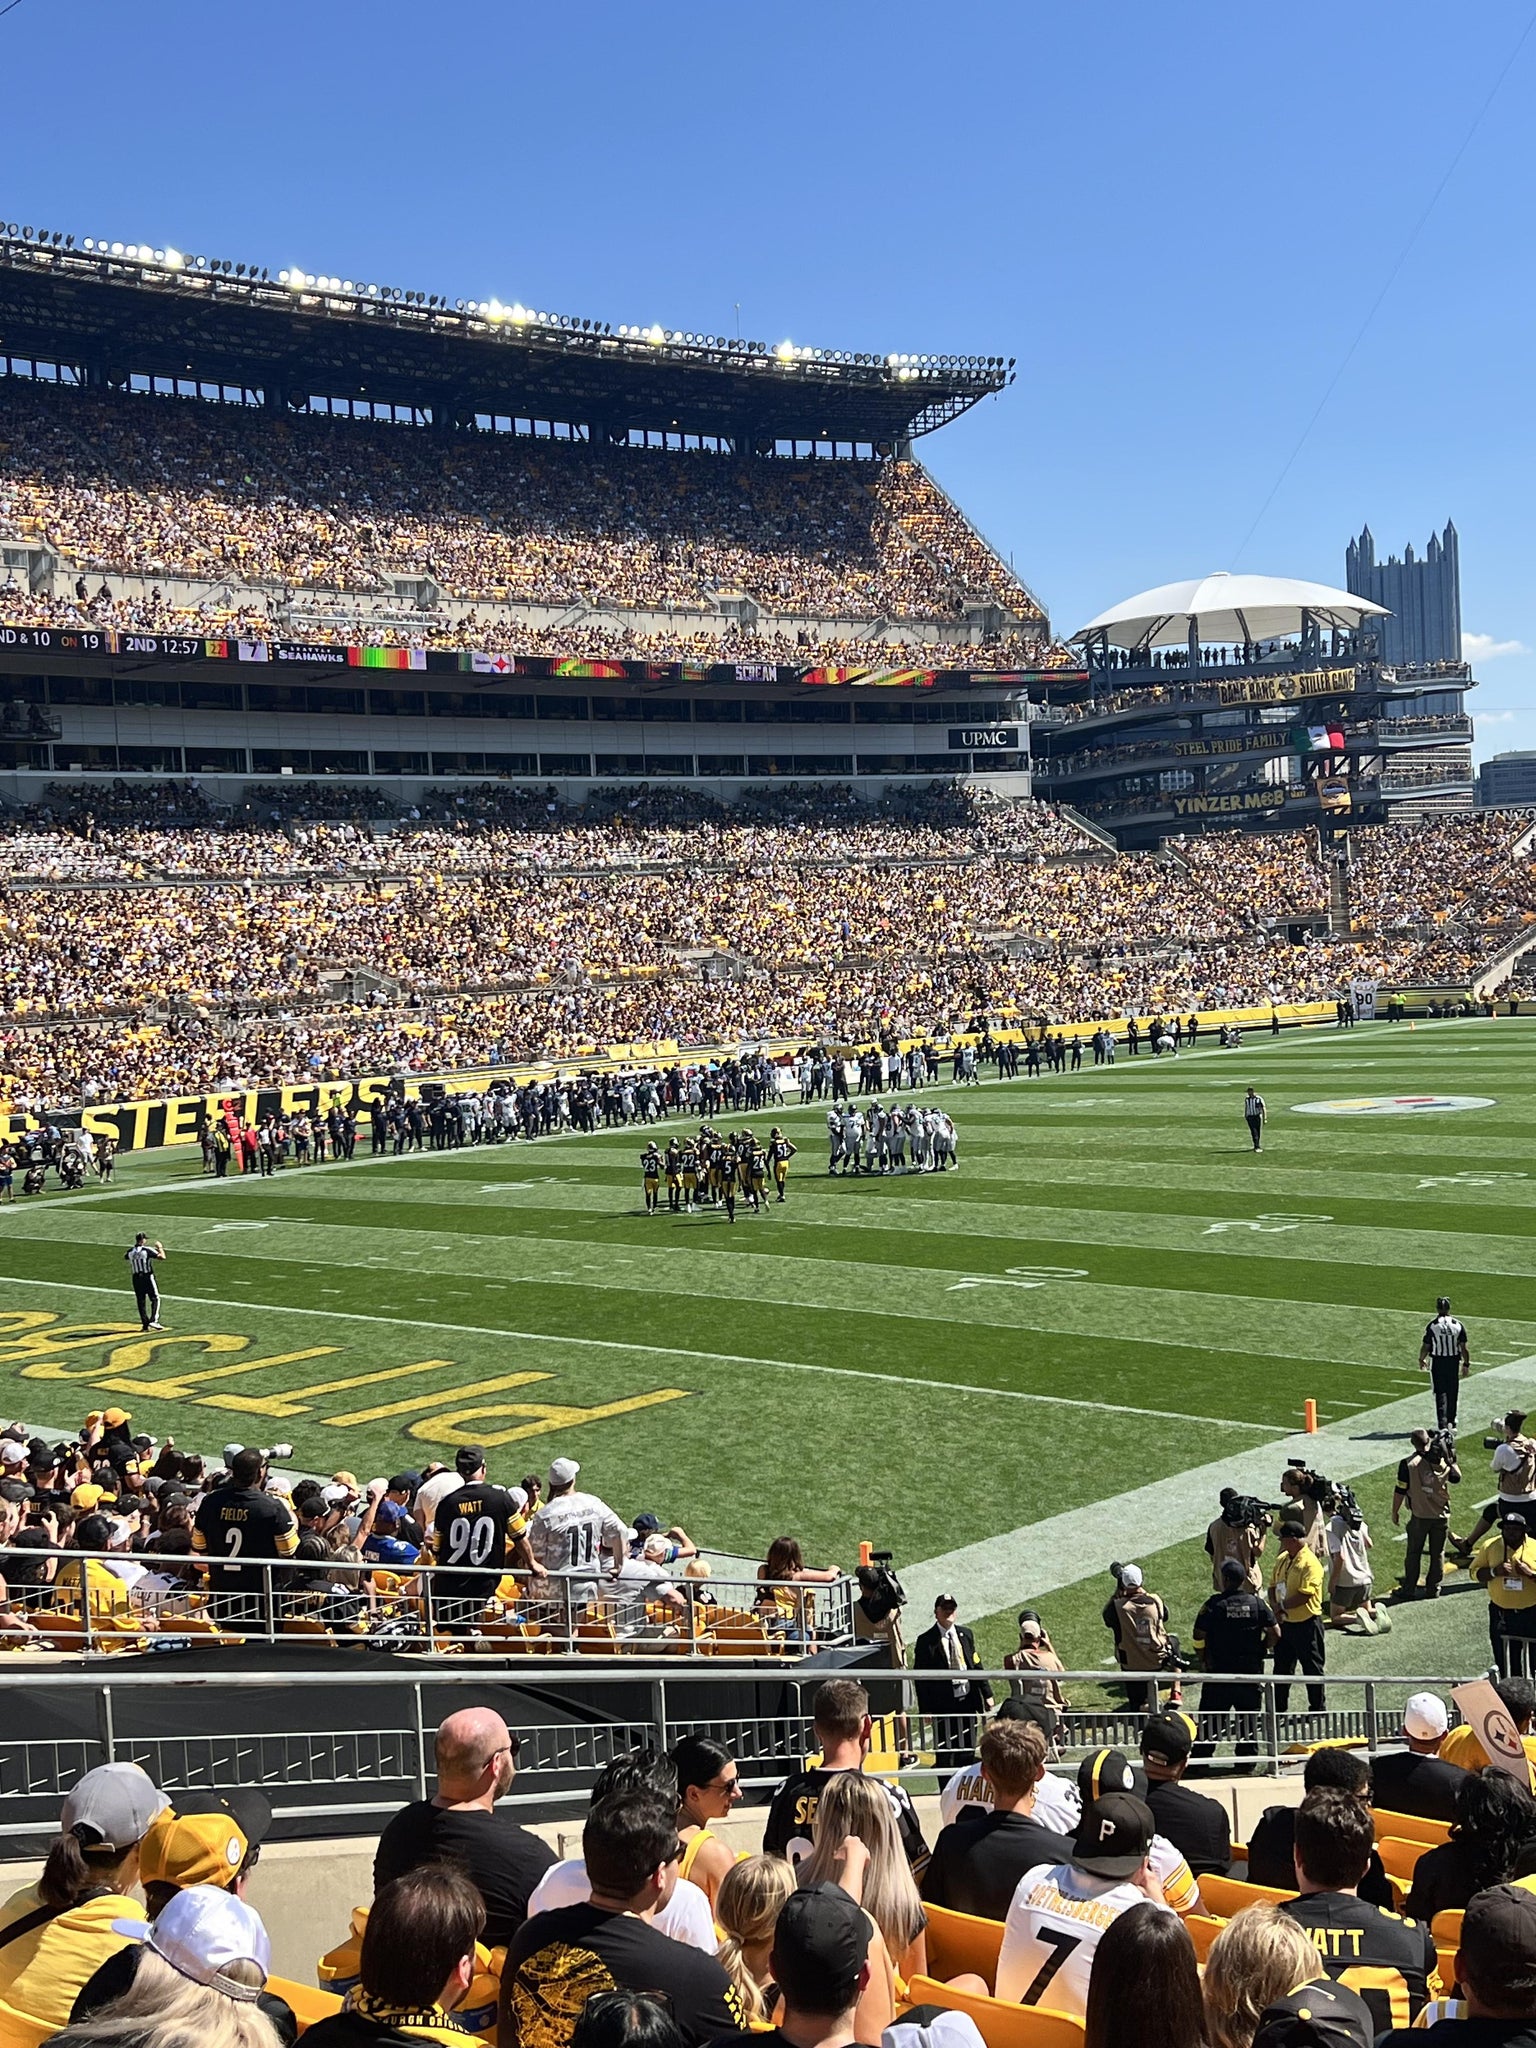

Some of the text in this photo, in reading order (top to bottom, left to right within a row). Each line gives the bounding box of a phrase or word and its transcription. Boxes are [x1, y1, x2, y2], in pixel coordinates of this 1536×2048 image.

[20, 634, 28, 644] &
[34, 632, 49, 646] 10
[61, 636, 77, 647] ON
[82, 635, 98, 649] 19
[126, 637, 198, 654] 2ND 12:57
[278, 649, 344, 662] SEAHAWKS
[1249, 680, 1276, 700] BANG
[1300, 673, 1332, 694] STILLER
[1331, 669, 1354, 691] GANG
[962, 731, 1007, 746] UPMC
[1174, 732, 1289, 756] STEEL PRIDE FAMILY
[1174, 794, 1244, 814] YINZER
[1355, 993, 1373, 1005] 90
[1205, 1212, 1334, 1234] 20
[953, 1265, 1089, 1291] 10
[220, 1507, 249, 1522] FIELDS
[459, 1500, 483, 1514] WATT
[223, 1527, 243, 1572] 2
[447, 1516, 495, 1566] 90
[567, 1522, 593, 1566] 11
[794, 1796, 819, 1825] SE
[1099, 1819, 1116, 1841] P
[1036, 1926, 1082, 2006] 7
